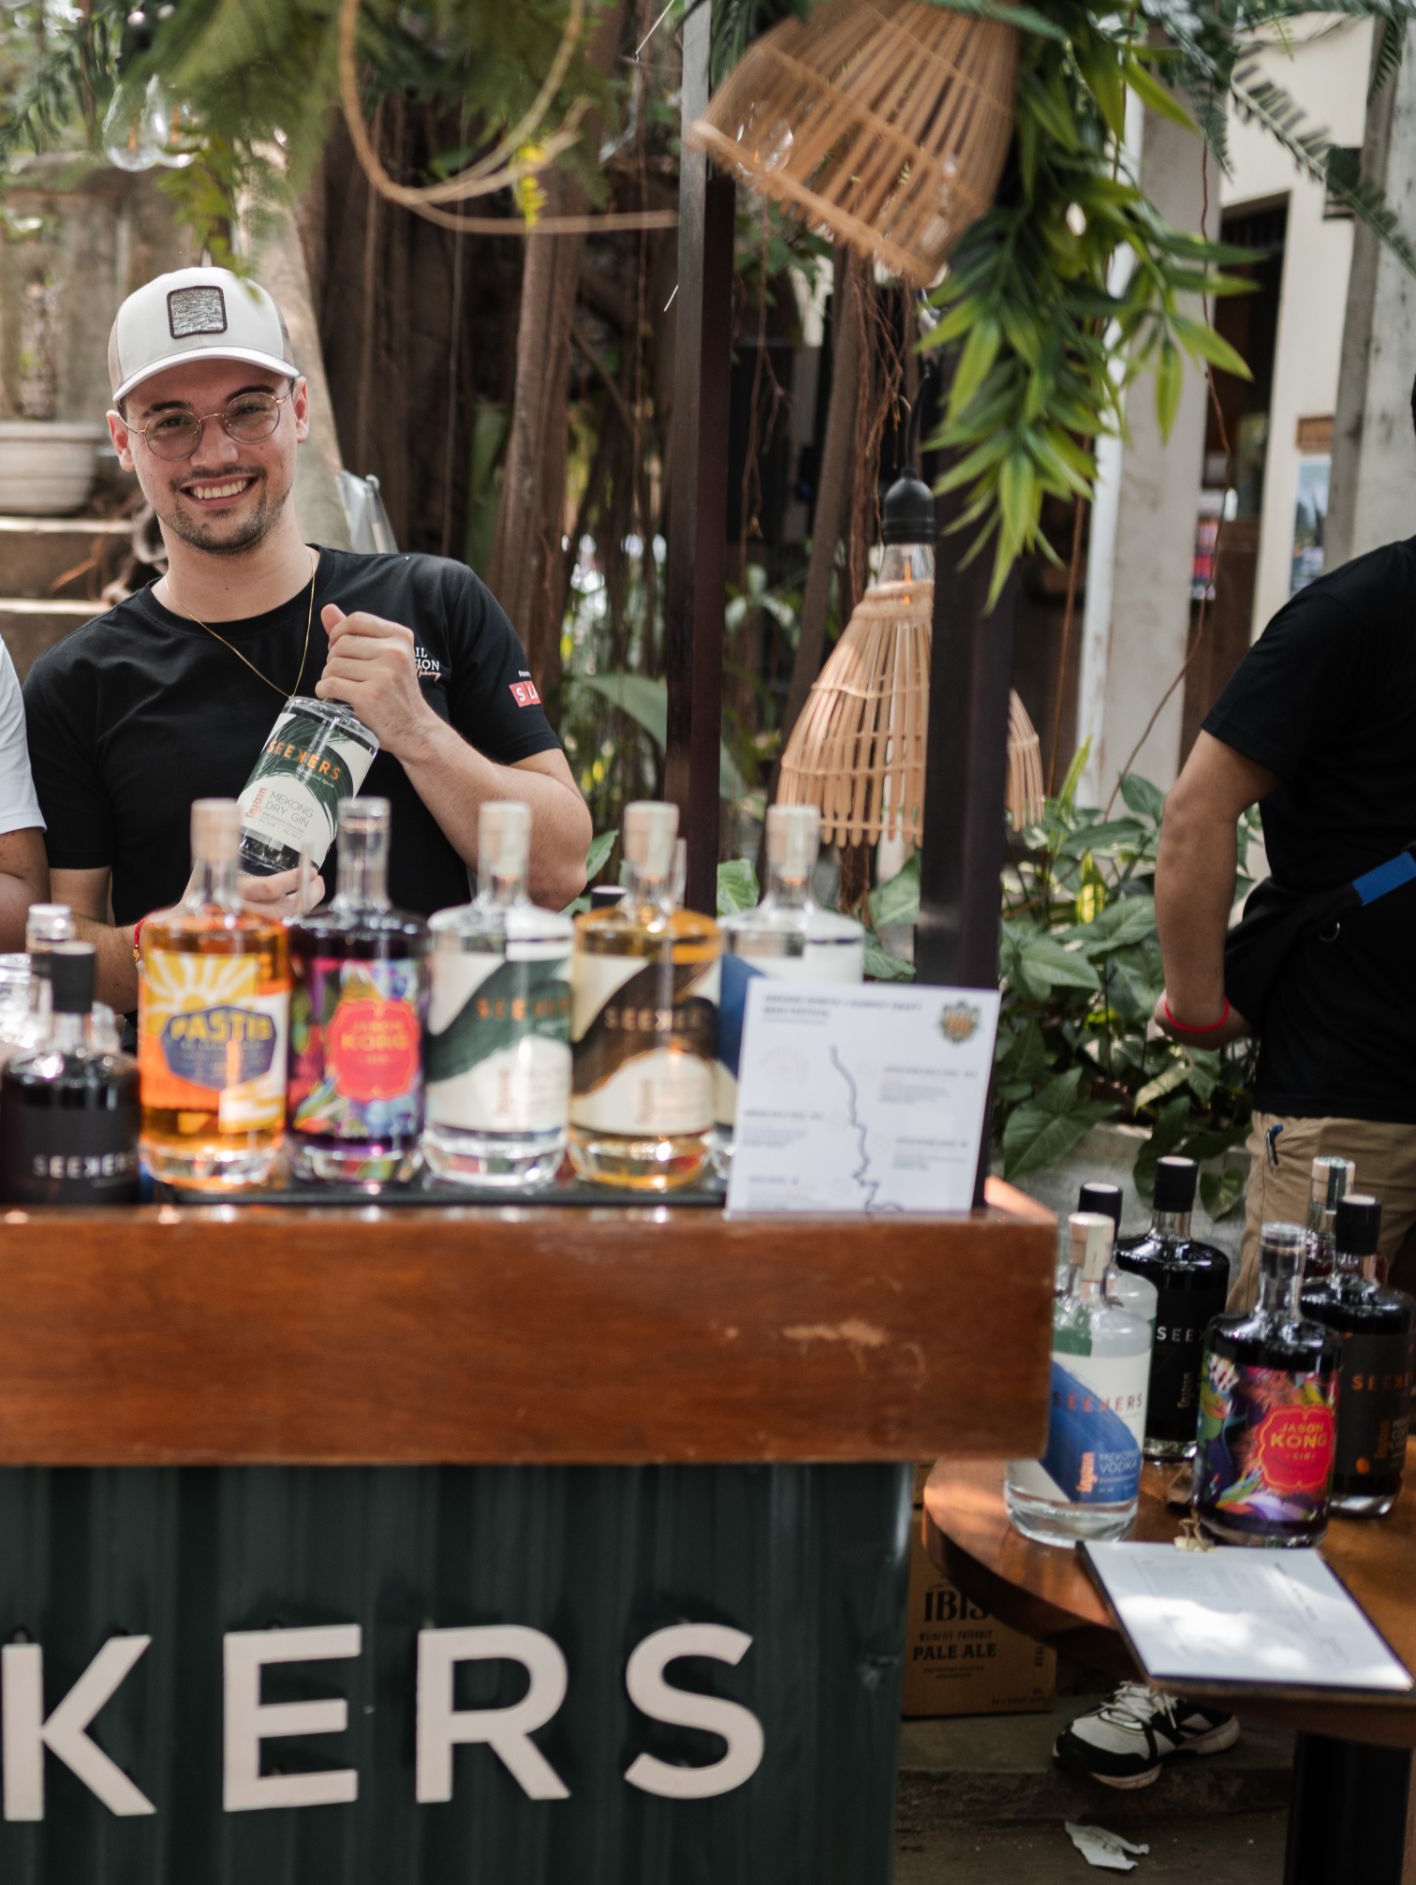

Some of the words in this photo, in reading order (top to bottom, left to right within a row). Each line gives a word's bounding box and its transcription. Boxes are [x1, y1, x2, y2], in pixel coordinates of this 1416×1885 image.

[266, 740, 341, 780] SEEKERS
[265, 800, 289, 818] DRY
[290, 812, 311, 828] GIN
[270, 791, 314, 817] MEKONG
[170, 1010, 273, 1041] PASTIS
[1052, 1392, 1144, 1413] SEEKERS
[1283, 1422, 1324, 1433] JASON
[1270, 1433, 1328, 1449] KONG
[1099, 1461, 1137, 1474] VODKA
[912, 1643, 958, 1661] PALE
[962, 1642, 998, 1659] ALE
